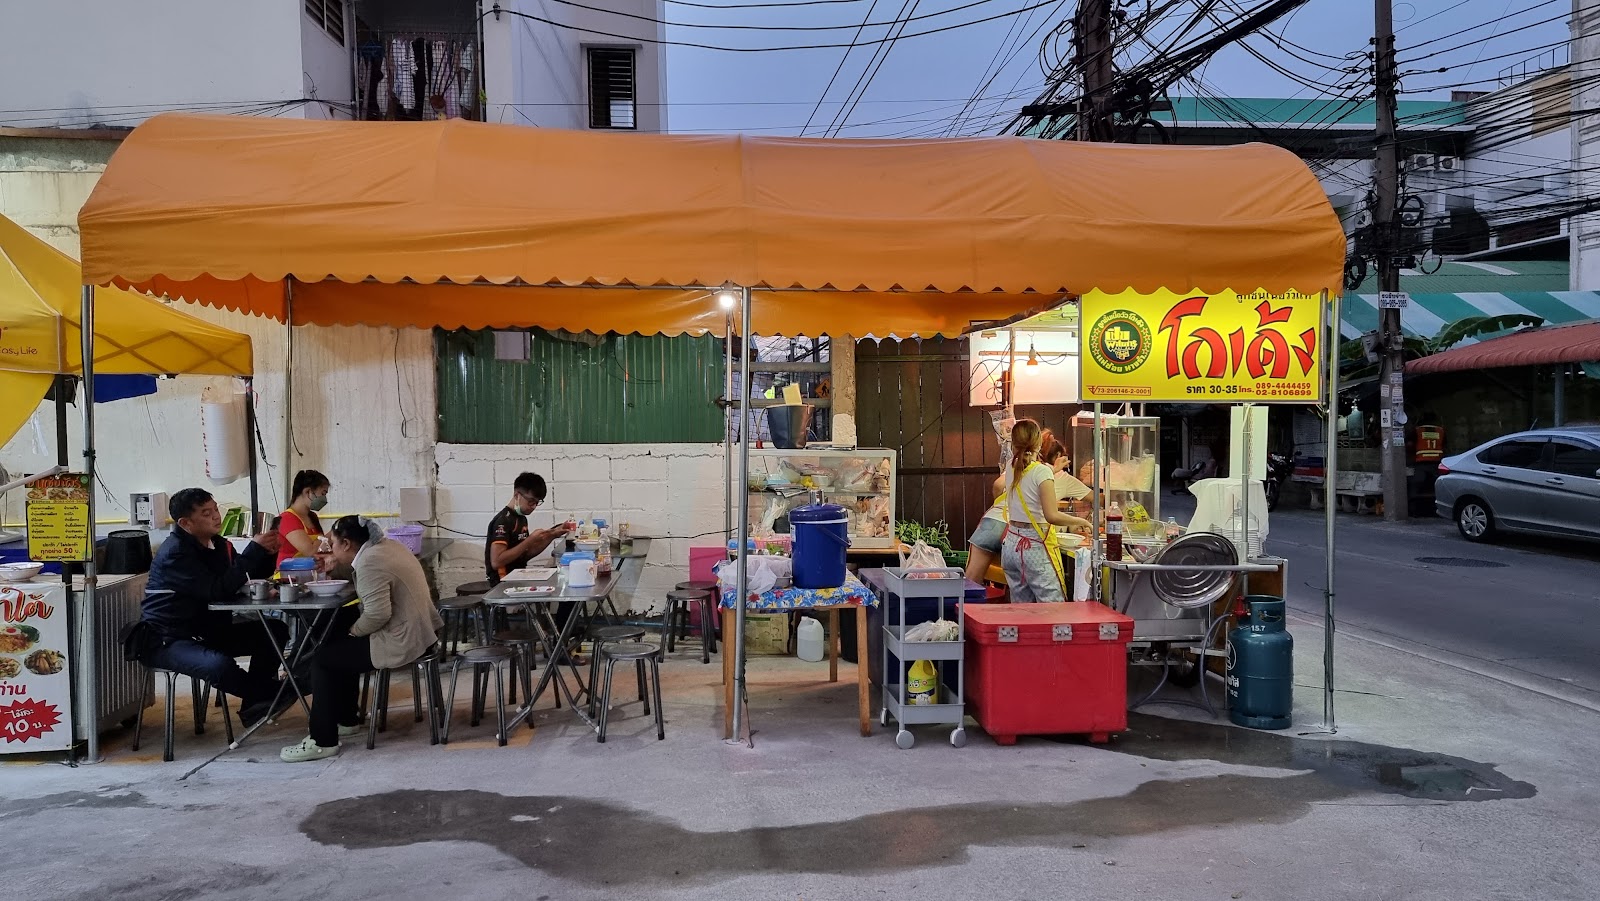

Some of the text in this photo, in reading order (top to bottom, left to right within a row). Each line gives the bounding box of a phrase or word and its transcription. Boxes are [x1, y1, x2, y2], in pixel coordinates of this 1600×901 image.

[0, 346, 38, 356] asy Life
[1186, 385, 1206, 394] ราคา
[1209, 385, 1238, 394] 30-35
[1426, 439, 1437, 449] 11
[4, 718, 47, 736] 10 บ.
